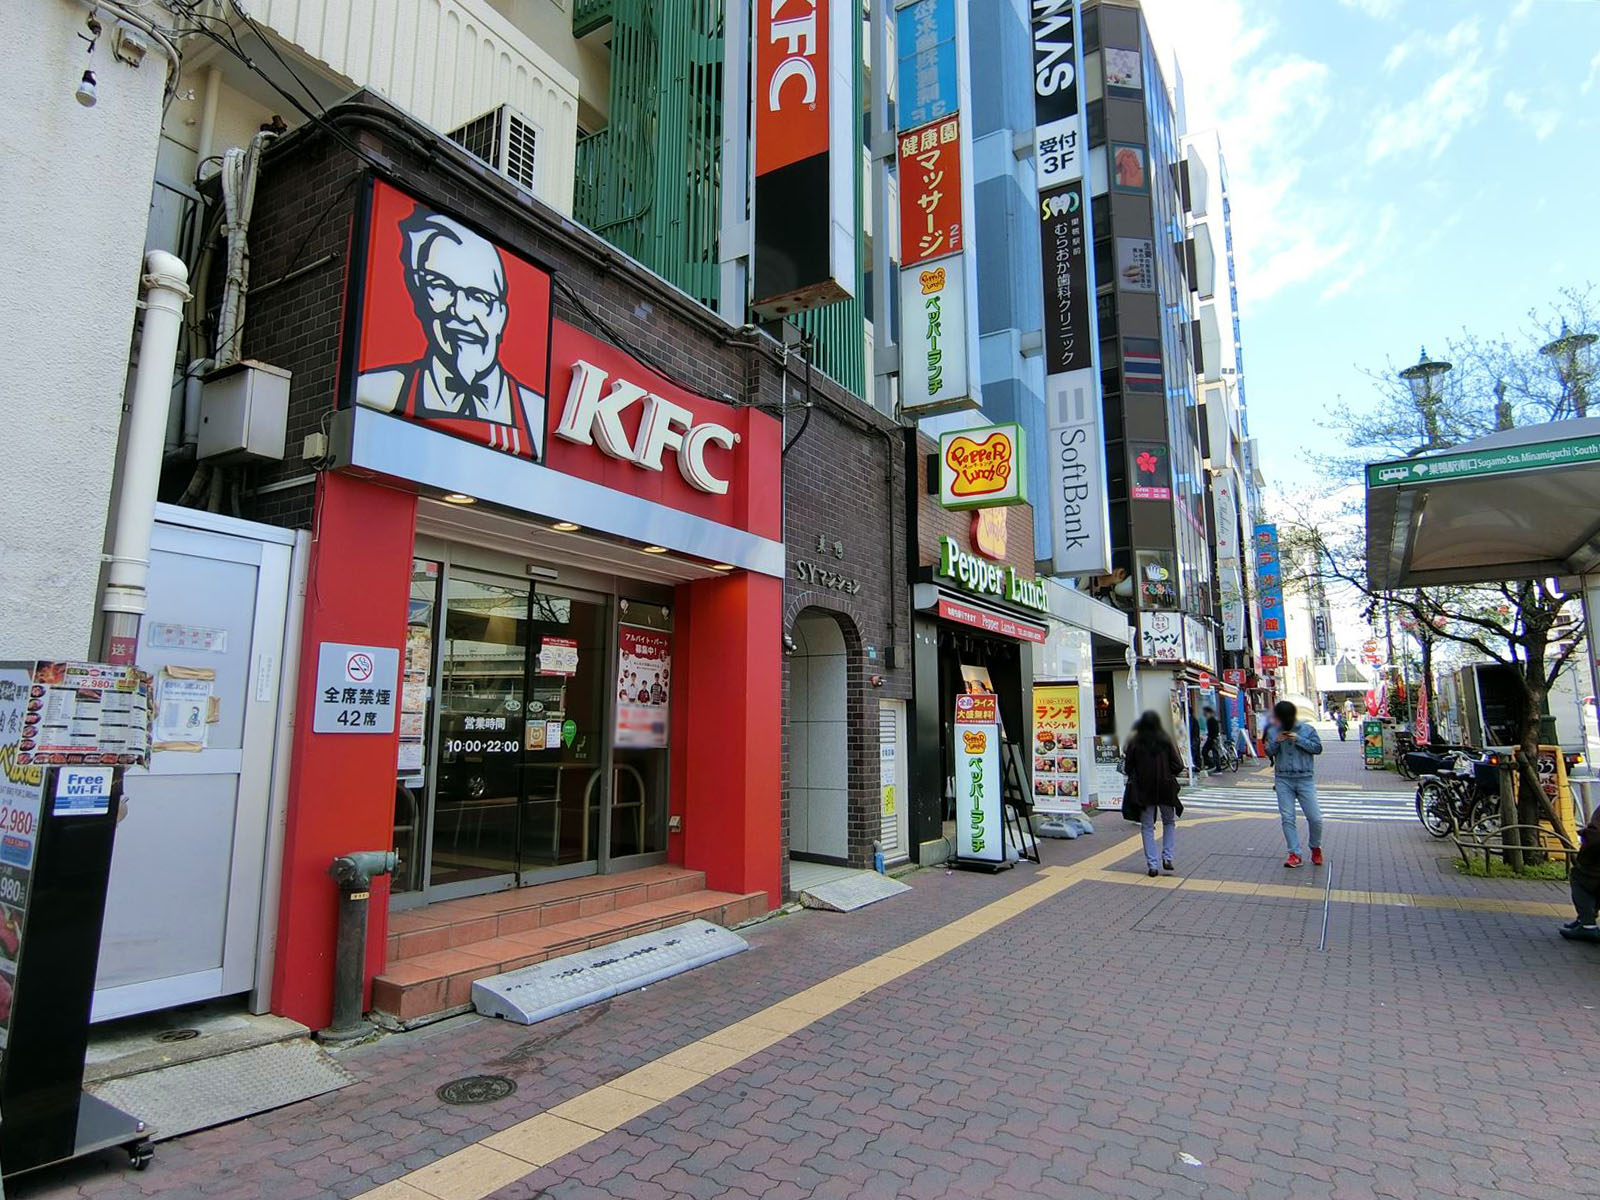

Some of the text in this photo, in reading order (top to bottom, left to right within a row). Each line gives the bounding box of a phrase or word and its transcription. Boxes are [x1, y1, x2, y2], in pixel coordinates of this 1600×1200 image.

[1039, 130, 1078, 157] 受付
[1043, 151, 1076, 175] 3F
[916, 149, 944, 257] マッサージ
[1054, 222, 1075, 366] むらおか歯科クリニック
[925, 295, 943, 396] ペッパーランチ
[553, 359, 737, 495] KFC
[1478, 456, 1508, 469] Sugamo
[1506, 454, 1520, 464] Sta.
[1521, 446, 1572, 462] Minamiguchi
[1060, 428, 1090, 550] SoftBank
[796, 559, 861, 596] SYマンション
[941, 534, 1049, 612] Pepper Lunch
[1143, 631, 1180, 645] ラーメン
[1226, 634, 1238, 643] 2F
[323, 686, 391, 706] 全席禁煙
[337, 710, 378, 727] 42席
[464, 716, 506, 731] 営業時間
[1036, 705, 1077, 720] ランチ
[1036, 721, 1077, 730] スペシャル
[67, 774, 104, 785] Free
[67, 784, 103, 795] Wi-Fi
[969, 757, 986, 852] ペッパーランチ
[0, 806, 33, 836] 2,980
